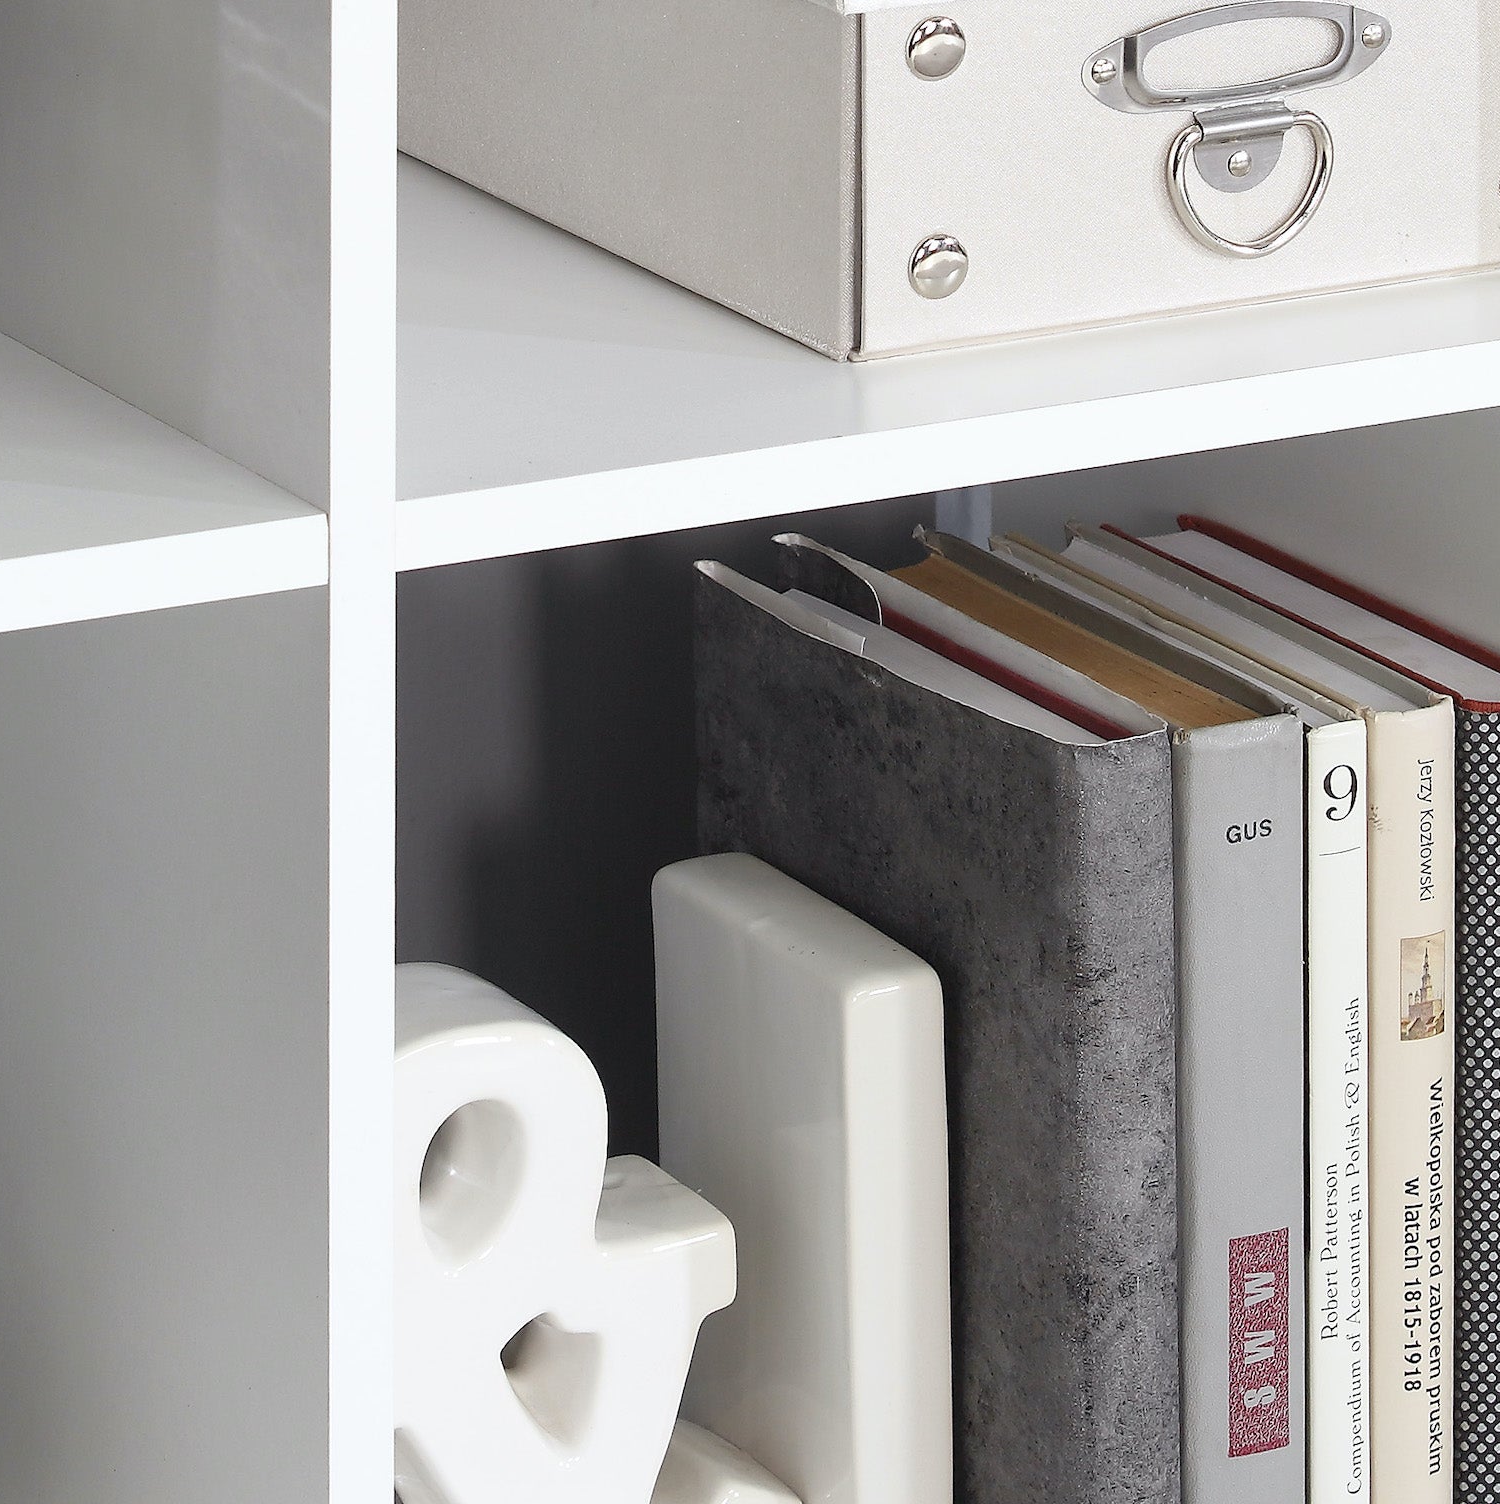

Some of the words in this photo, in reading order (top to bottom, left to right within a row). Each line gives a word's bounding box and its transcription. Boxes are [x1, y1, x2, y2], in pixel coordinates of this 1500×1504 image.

[1323, 764, 1358, 822] 9
[1417, 759, 1435, 803] Jerzy
[1226, 818, 1273, 844] GUS
[1419, 808, 1435, 902] Kozłowski
[1345, 997, 1362, 1074] English
[1344, 1082, 1360, 1110] &
[1345, 1113, 1360, 1178] Polish
[1426, 1076, 1444, 1230] Wielkopolska
[1320, 1163, 1338, 1262] Patterson
[1347, 1183, 1360, 1204] in
[1404, 1175, 1420, 1197] w
[1346, 1208, 1363, 1324] Accounting
[1404, 1203, 1424, 1270] latach
[1426, 1235, 1444, 1278] pod
[1320, 1270, 1339, 1340] Robert
[1404, 1276, 1422, 1393] 1815-1918
[1429, 1282, 1444, 1380] zaborem
[1346, 1333, 1361, 1353] of
[1346, 1359, 1365, 1495] Compendium
[1426, 1384, 1444, 1475] pruskim
